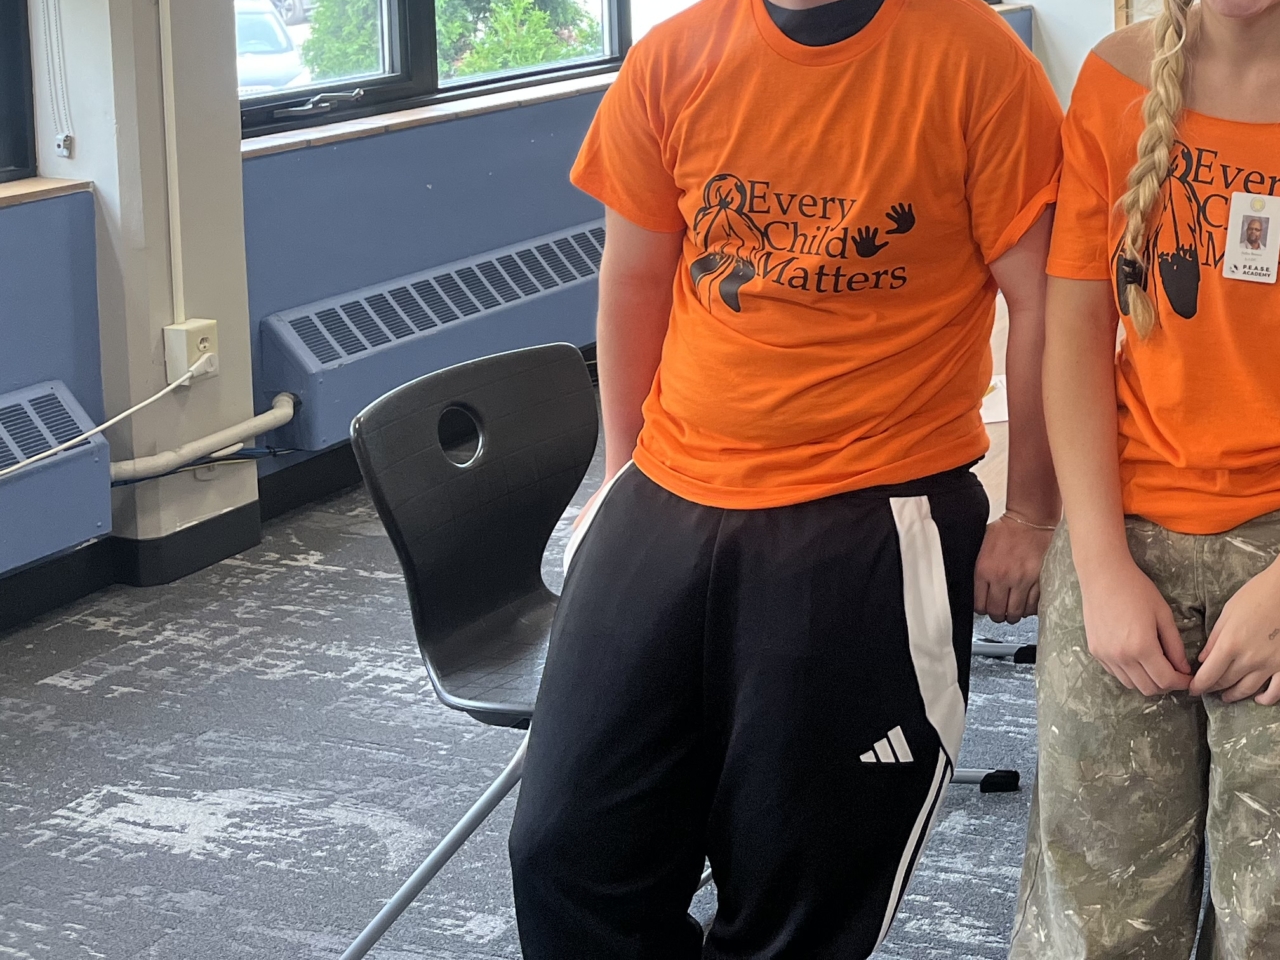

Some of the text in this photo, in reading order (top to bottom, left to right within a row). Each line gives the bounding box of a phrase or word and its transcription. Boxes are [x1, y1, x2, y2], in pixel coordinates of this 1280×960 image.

[747, 180, 857, 232] Every
[762, 220, 849, 259] Child
[755, 251, 908, 294] Matters
[1242, 270, 1271, 278] ACADEMY
